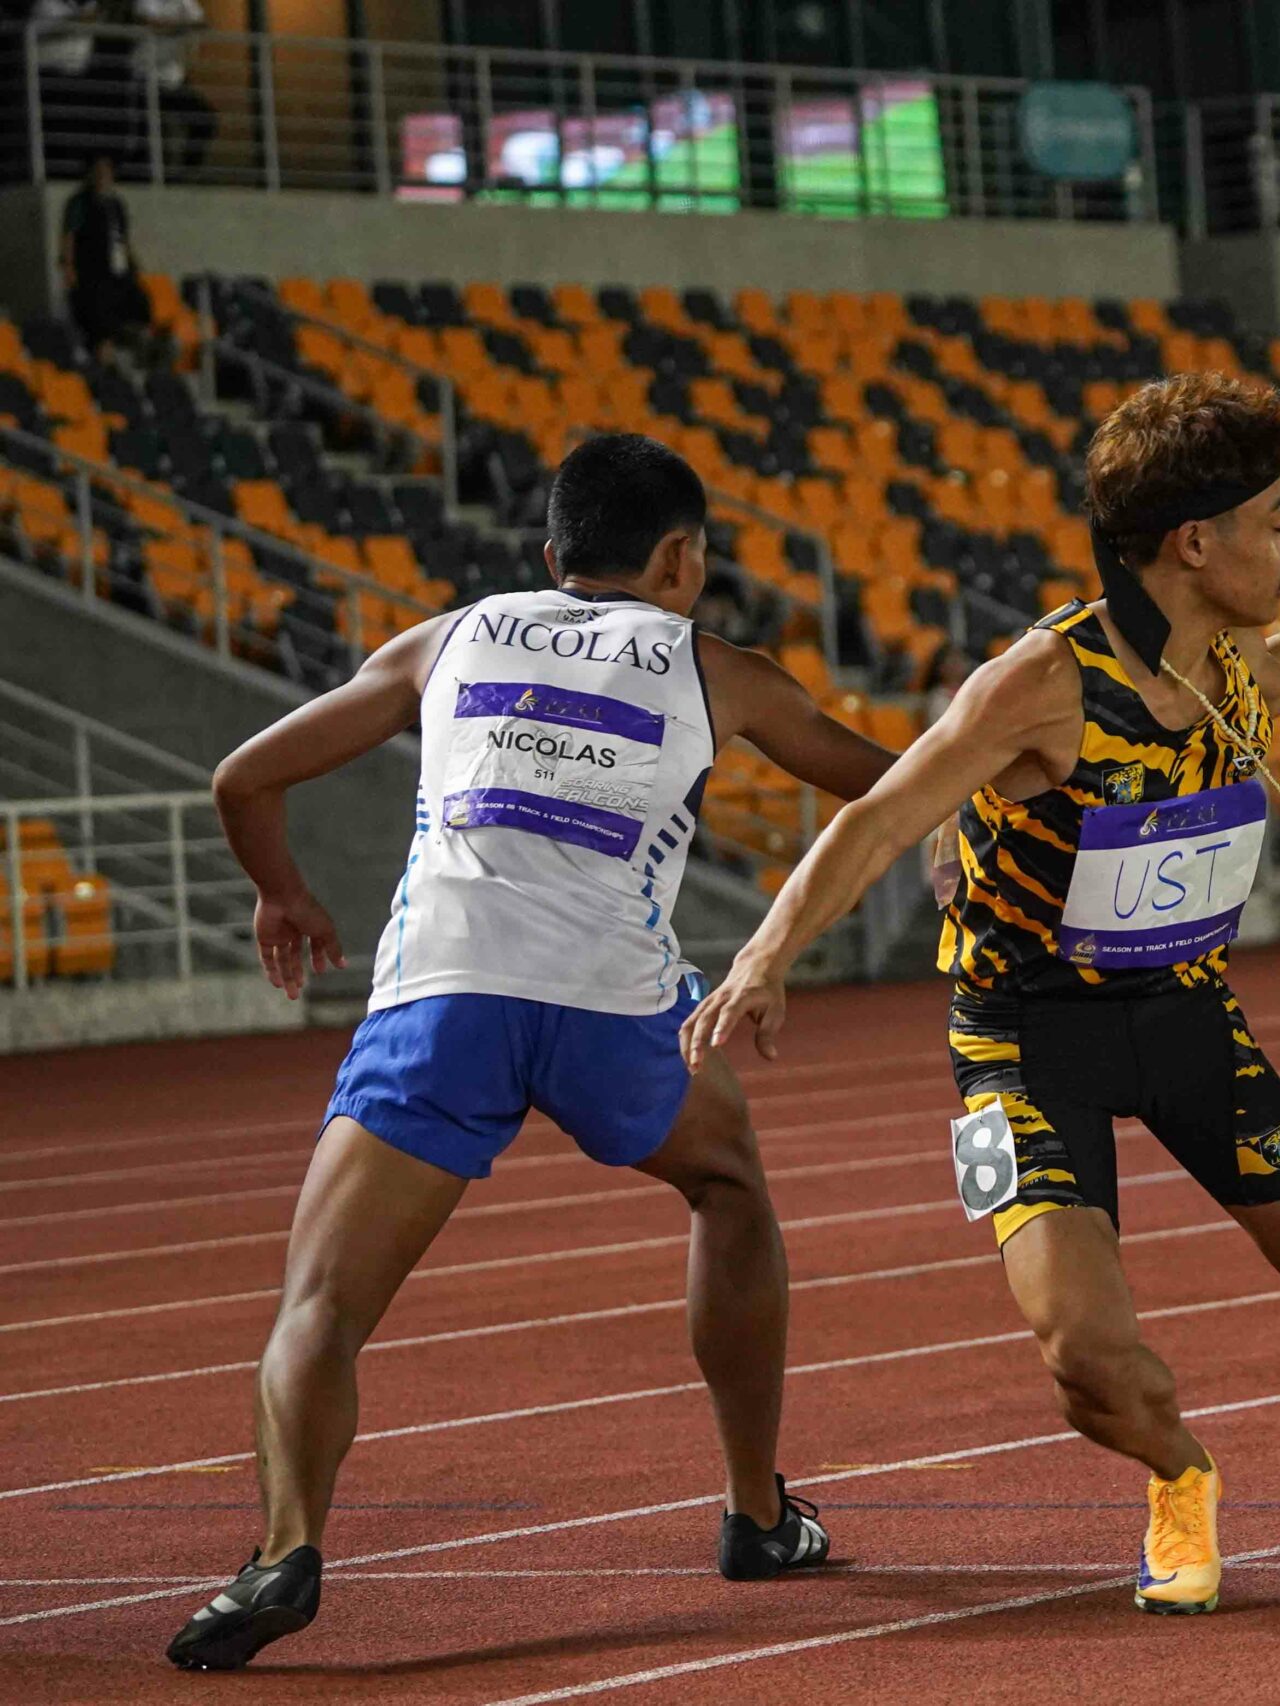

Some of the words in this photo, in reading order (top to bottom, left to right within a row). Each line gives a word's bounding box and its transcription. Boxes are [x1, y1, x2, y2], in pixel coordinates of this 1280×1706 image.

[470, 612, 673, 676] NICOLAS
[487, 730, 616, 768] NICOLAS
[534, 769, 555, 781] 511
[558, 779, 631, 794] SOARING
[552, 788, 650, 813] FALCONS
[518, 805, 541, 817] TRACK
[550, 814, 570, 823] FIELD
[1114, 841, 1231, 919] UST
[1145, 943, 1167, 952] TRACK
[1175, 938, 1193, 947] FIELD
[956, 1110, 1013, 1211] 8
